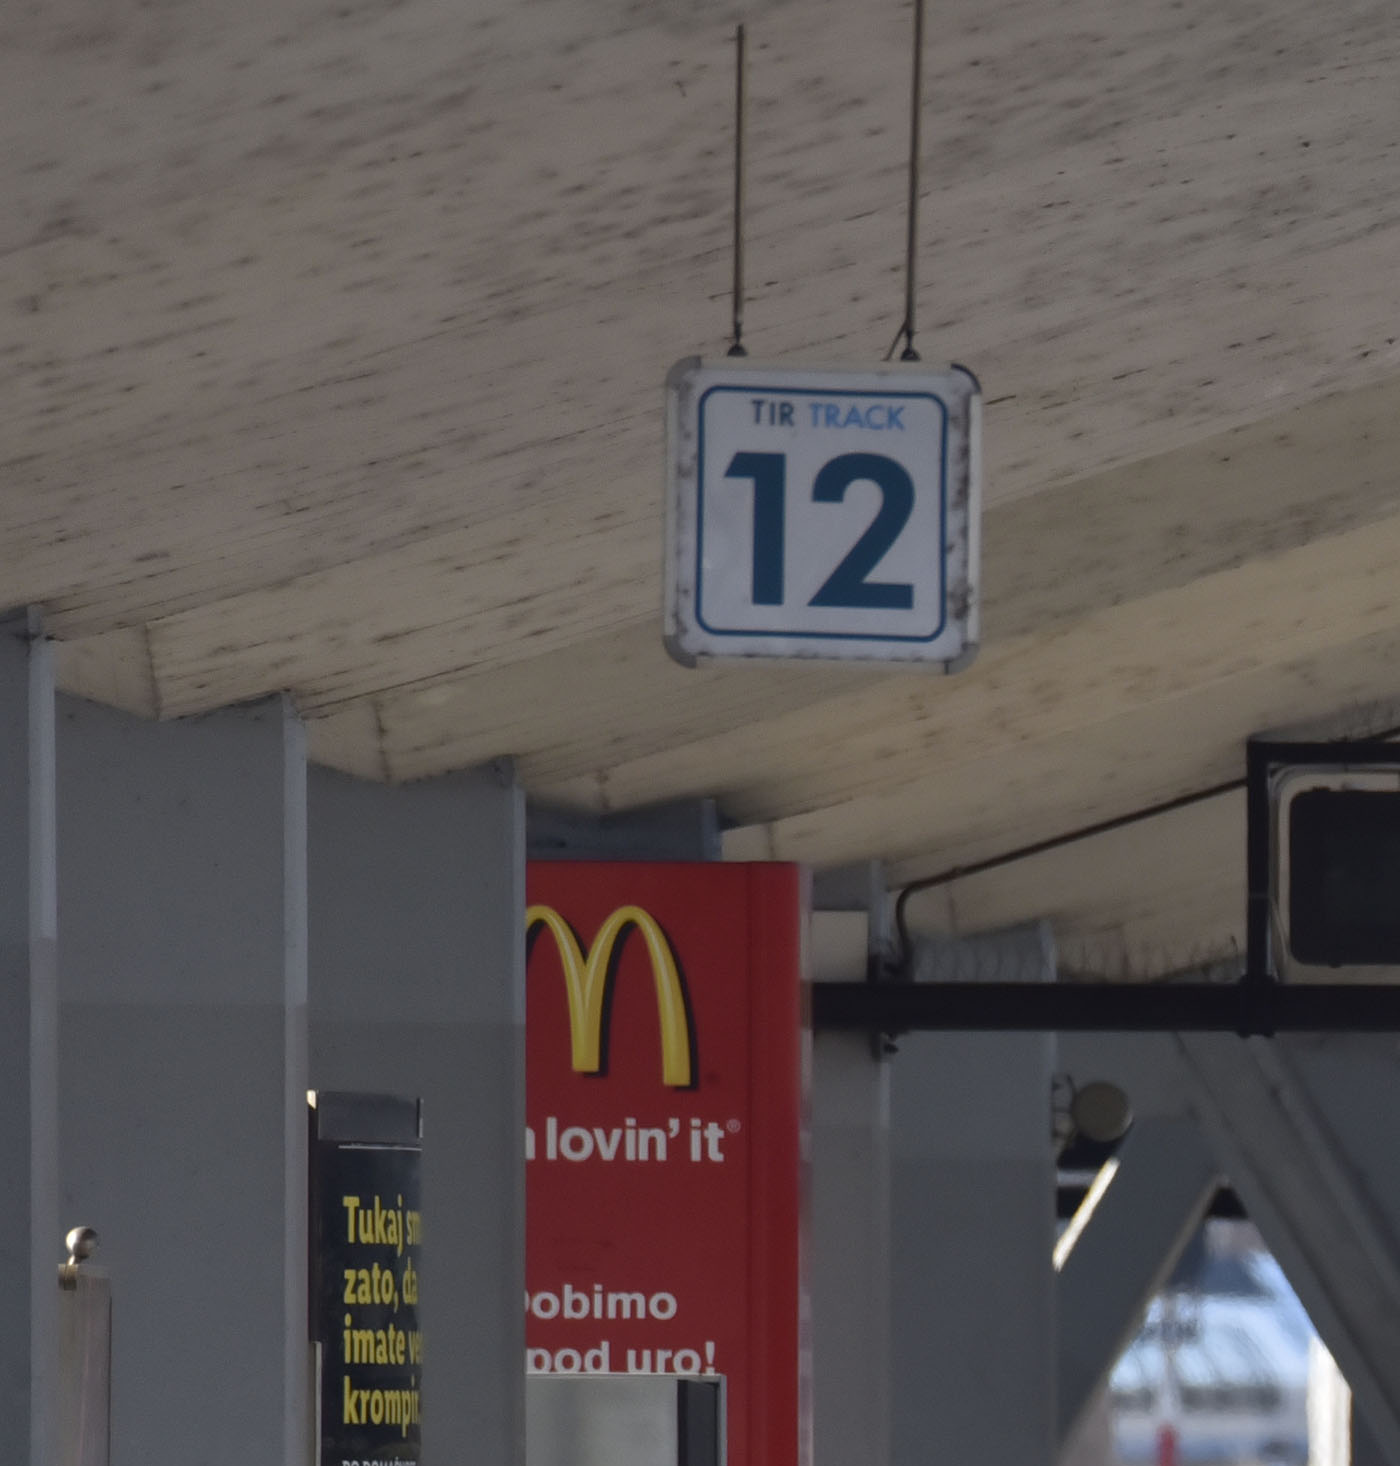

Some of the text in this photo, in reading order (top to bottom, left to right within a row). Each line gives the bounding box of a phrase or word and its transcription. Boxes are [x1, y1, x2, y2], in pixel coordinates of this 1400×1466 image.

[751, 399, 905, 431] TIR TRACK
[723, 451, 916, 610] 12
[343, 1194, 403, 1259] Tukaj
[343, 1262, 400, 1313] zato,
[525, 1284, 679, 1321] obimo
[343, 1313, 406, 1365] imate
[626, 1340, 716, 1375] uro!
